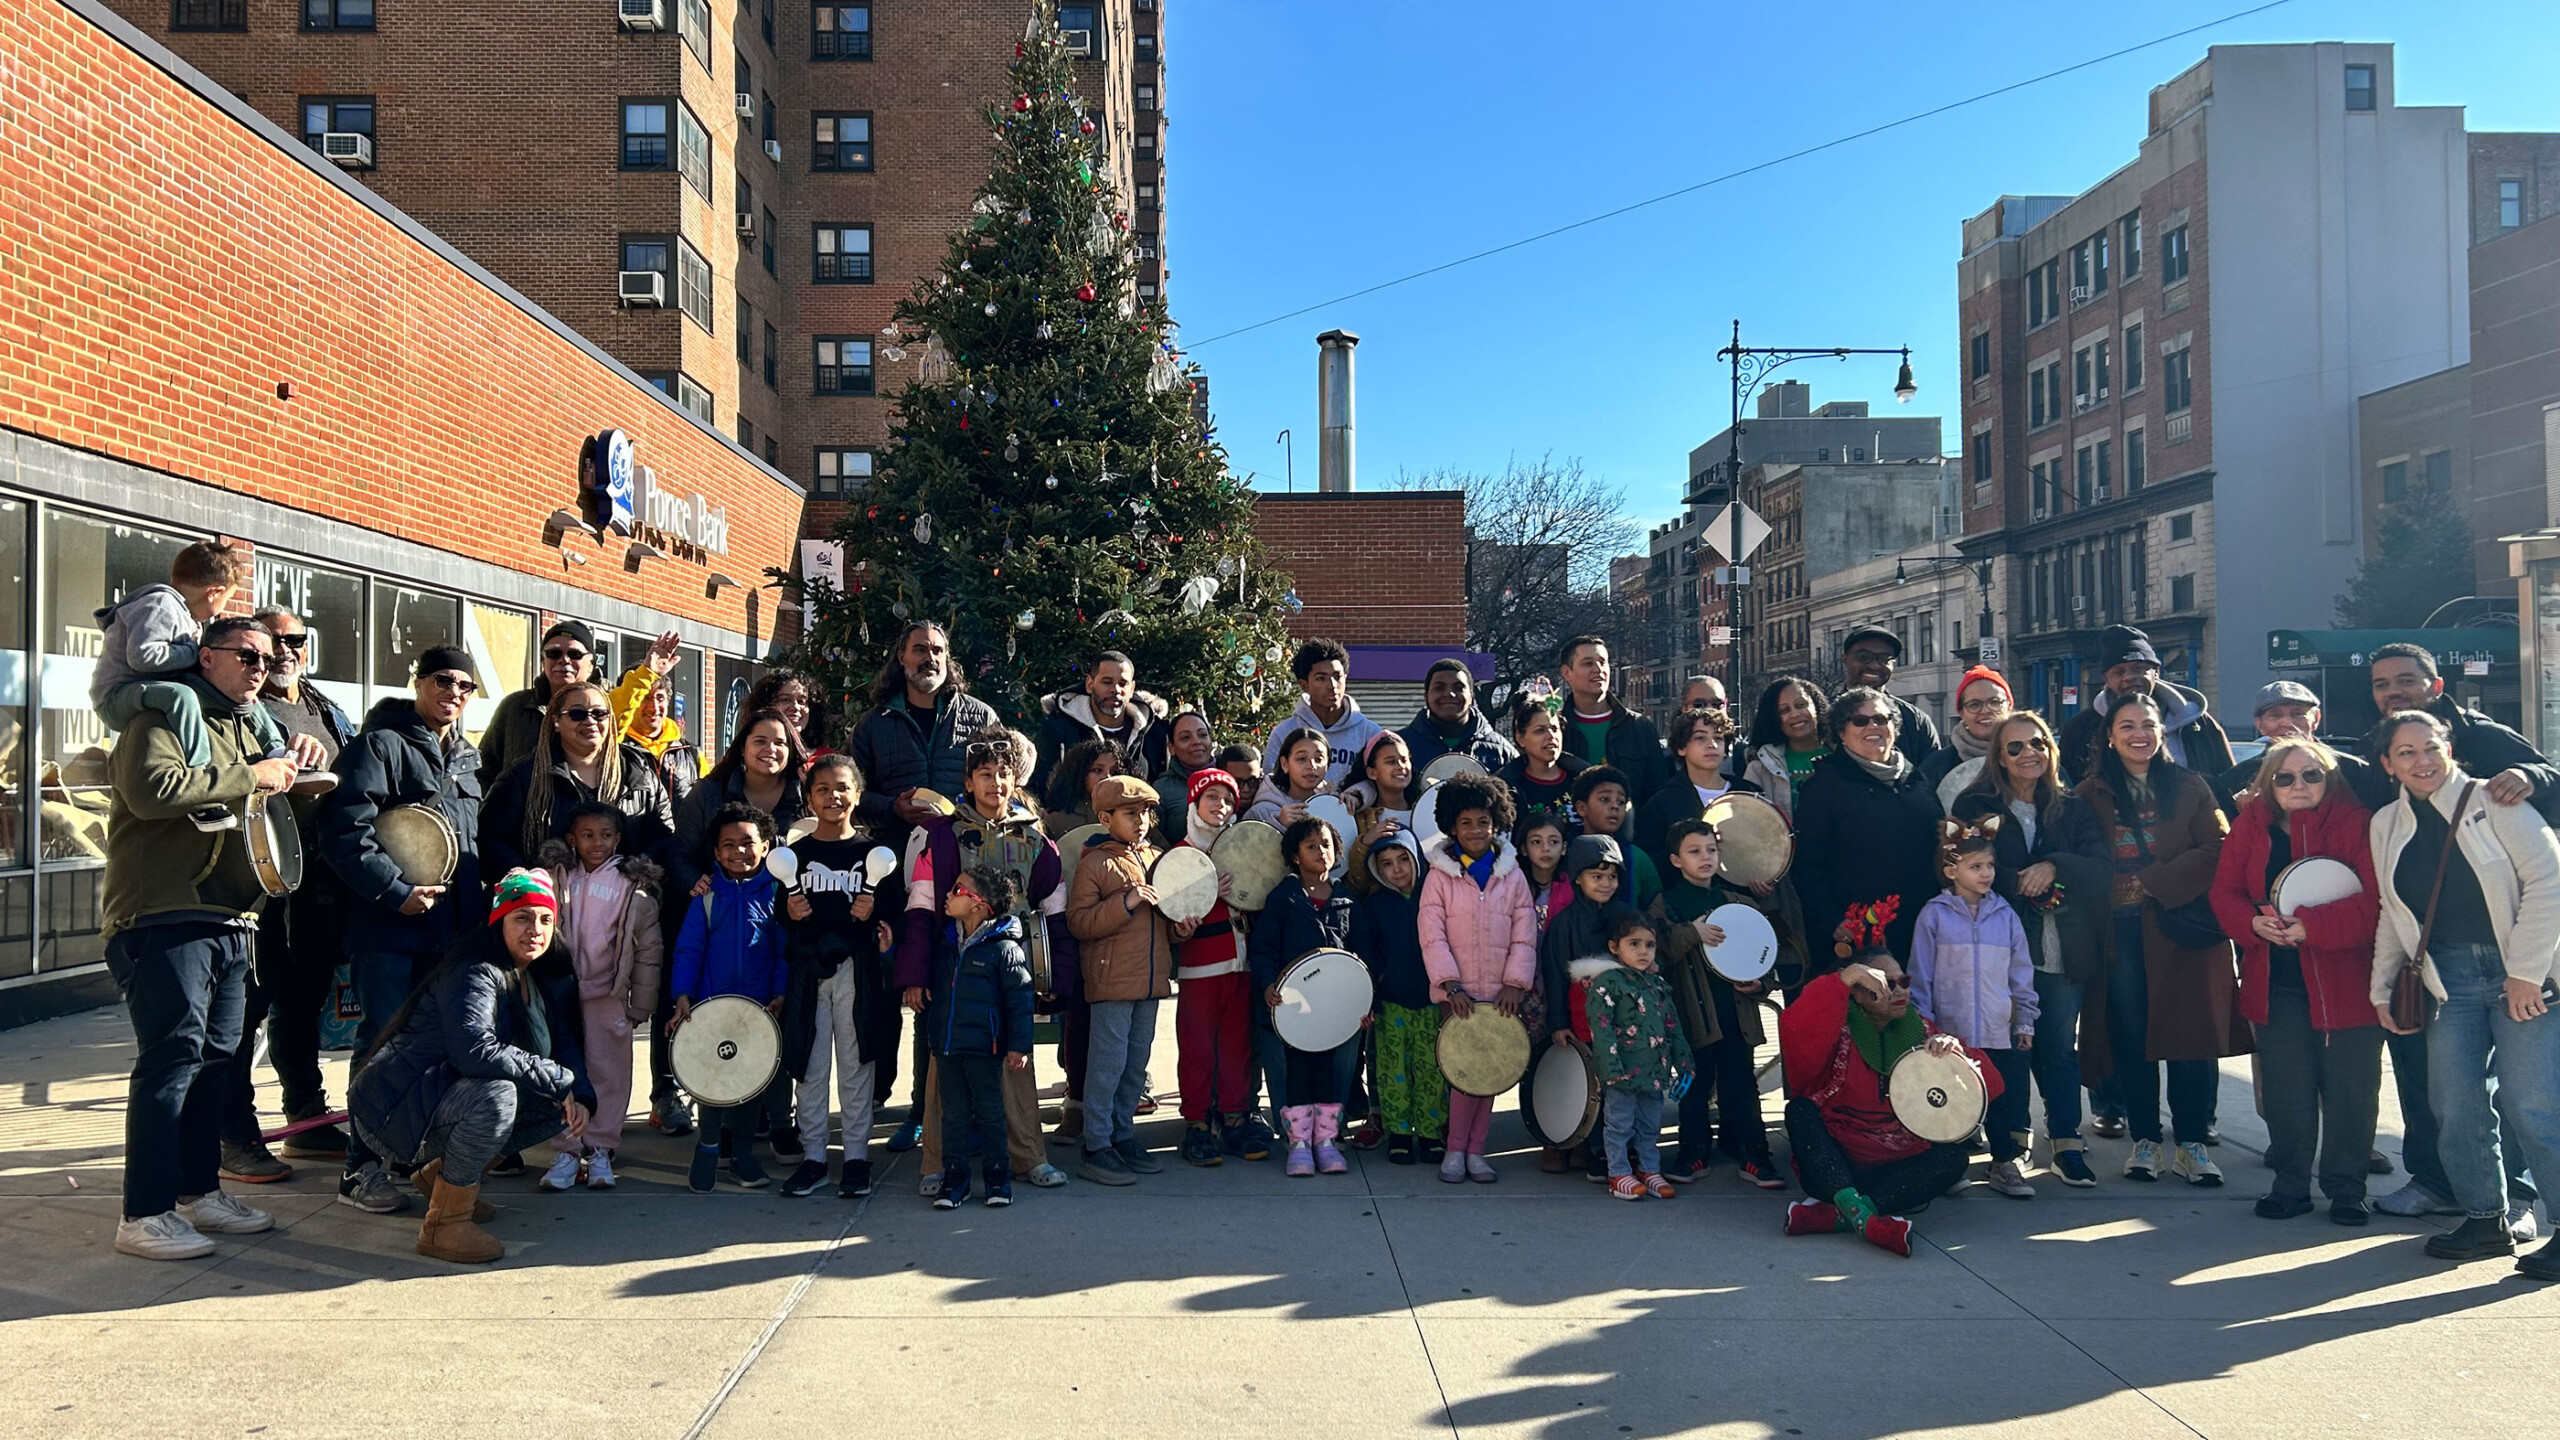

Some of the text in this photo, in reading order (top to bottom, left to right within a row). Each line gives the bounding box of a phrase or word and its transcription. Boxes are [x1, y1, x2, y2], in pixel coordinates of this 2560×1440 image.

[643, 465, 730, 558] Ponce Bank
[253, 559, 313, 618] WE'VE
[1982, 650, 1998, 660] 25
[2448, 650, 2495, 665] Health
[588, 881, 620, 903] NAVY
[800, 869, 863, 895] PUMA
[341, 1004, 361, 1013] ALD
